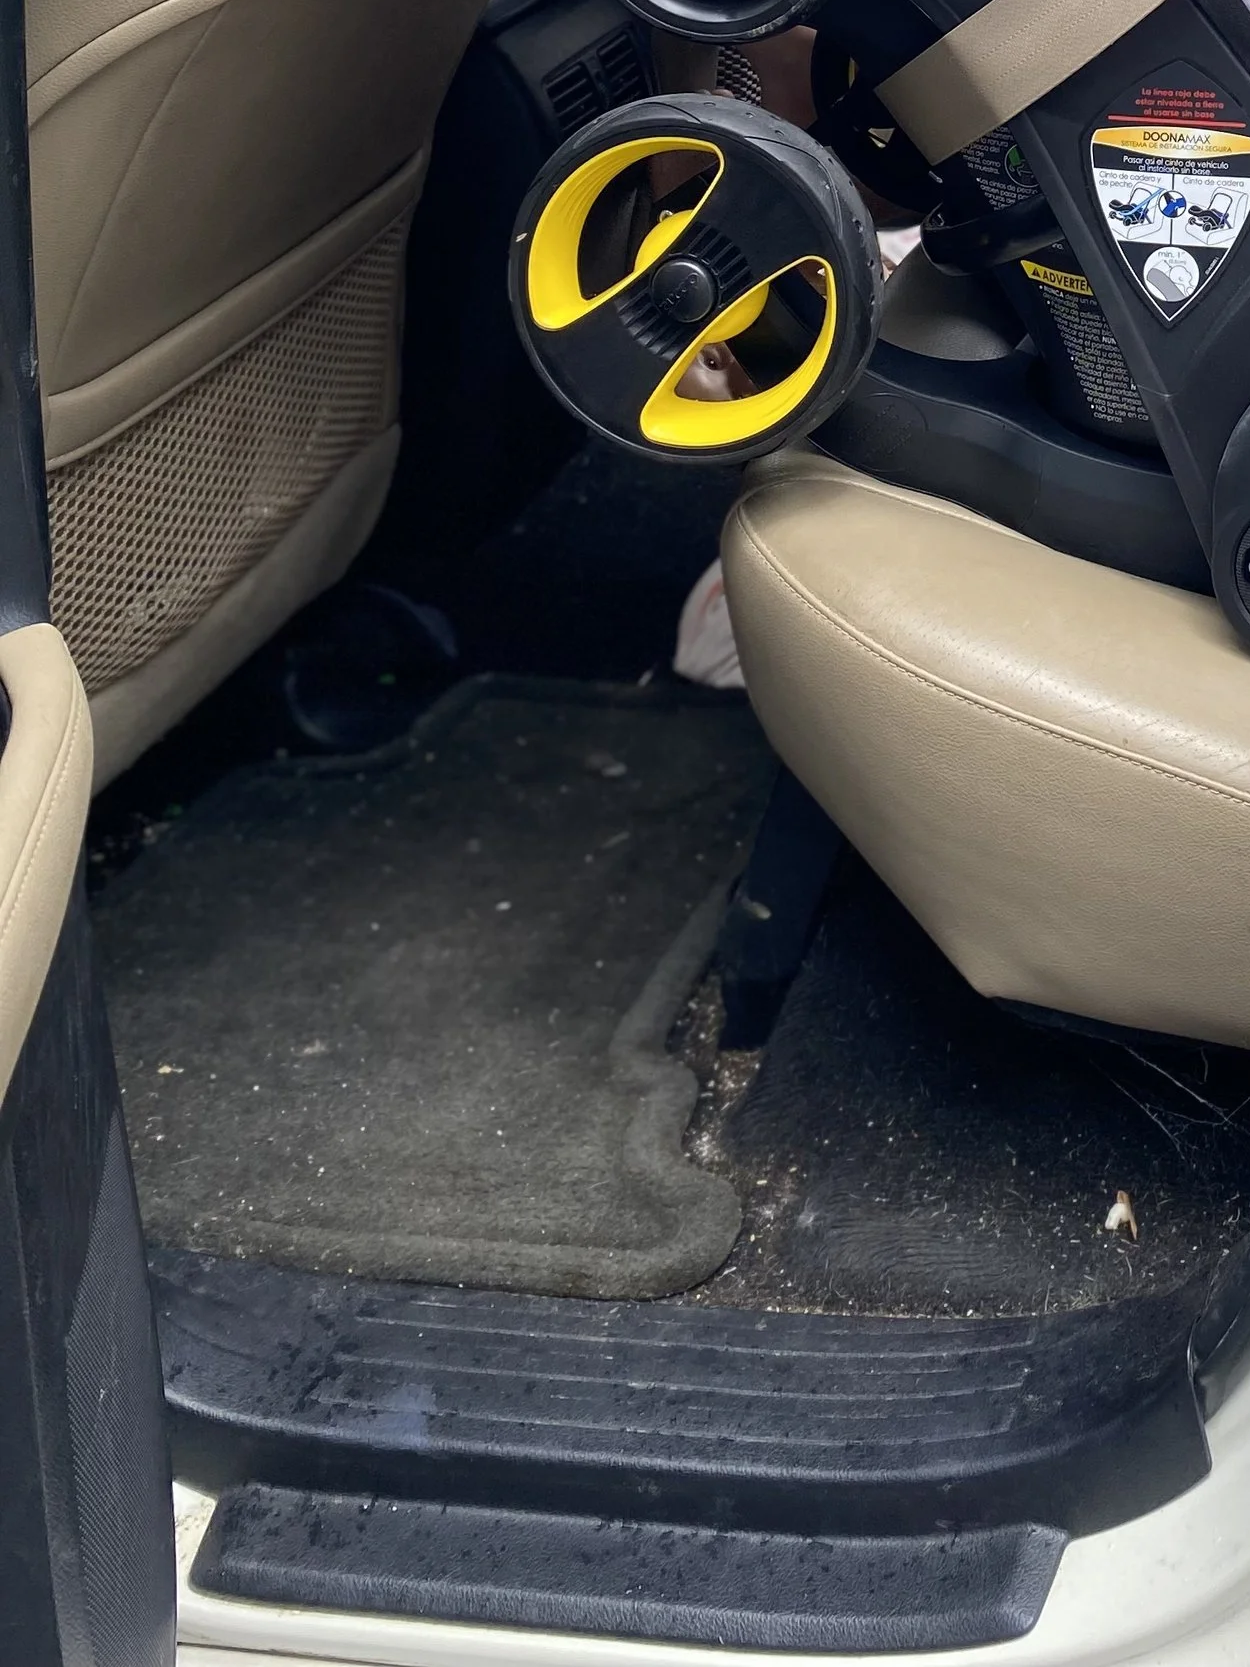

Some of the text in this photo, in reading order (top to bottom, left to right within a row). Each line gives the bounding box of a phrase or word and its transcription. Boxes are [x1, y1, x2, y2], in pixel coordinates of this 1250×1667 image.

[1142, 88, 1151, 96] La
[1143, 131, 1211, 145] DOONAMAX
[1121, 140, 1147, 148] SISTEMA
[1123, 155, 1143, 164] Pasar
[1165, 158, 1184, 167] cinto
[1185, 160, 1195, 168] de
[1099, 171, 1118, 179] Cinto
[1129, 174, 1156, 182] cadera
[1156, 176, 1162, 184] y
[1182, 177, 1244, 188] Cinto de cadera
[1095, 405, 1106, 413] NO
